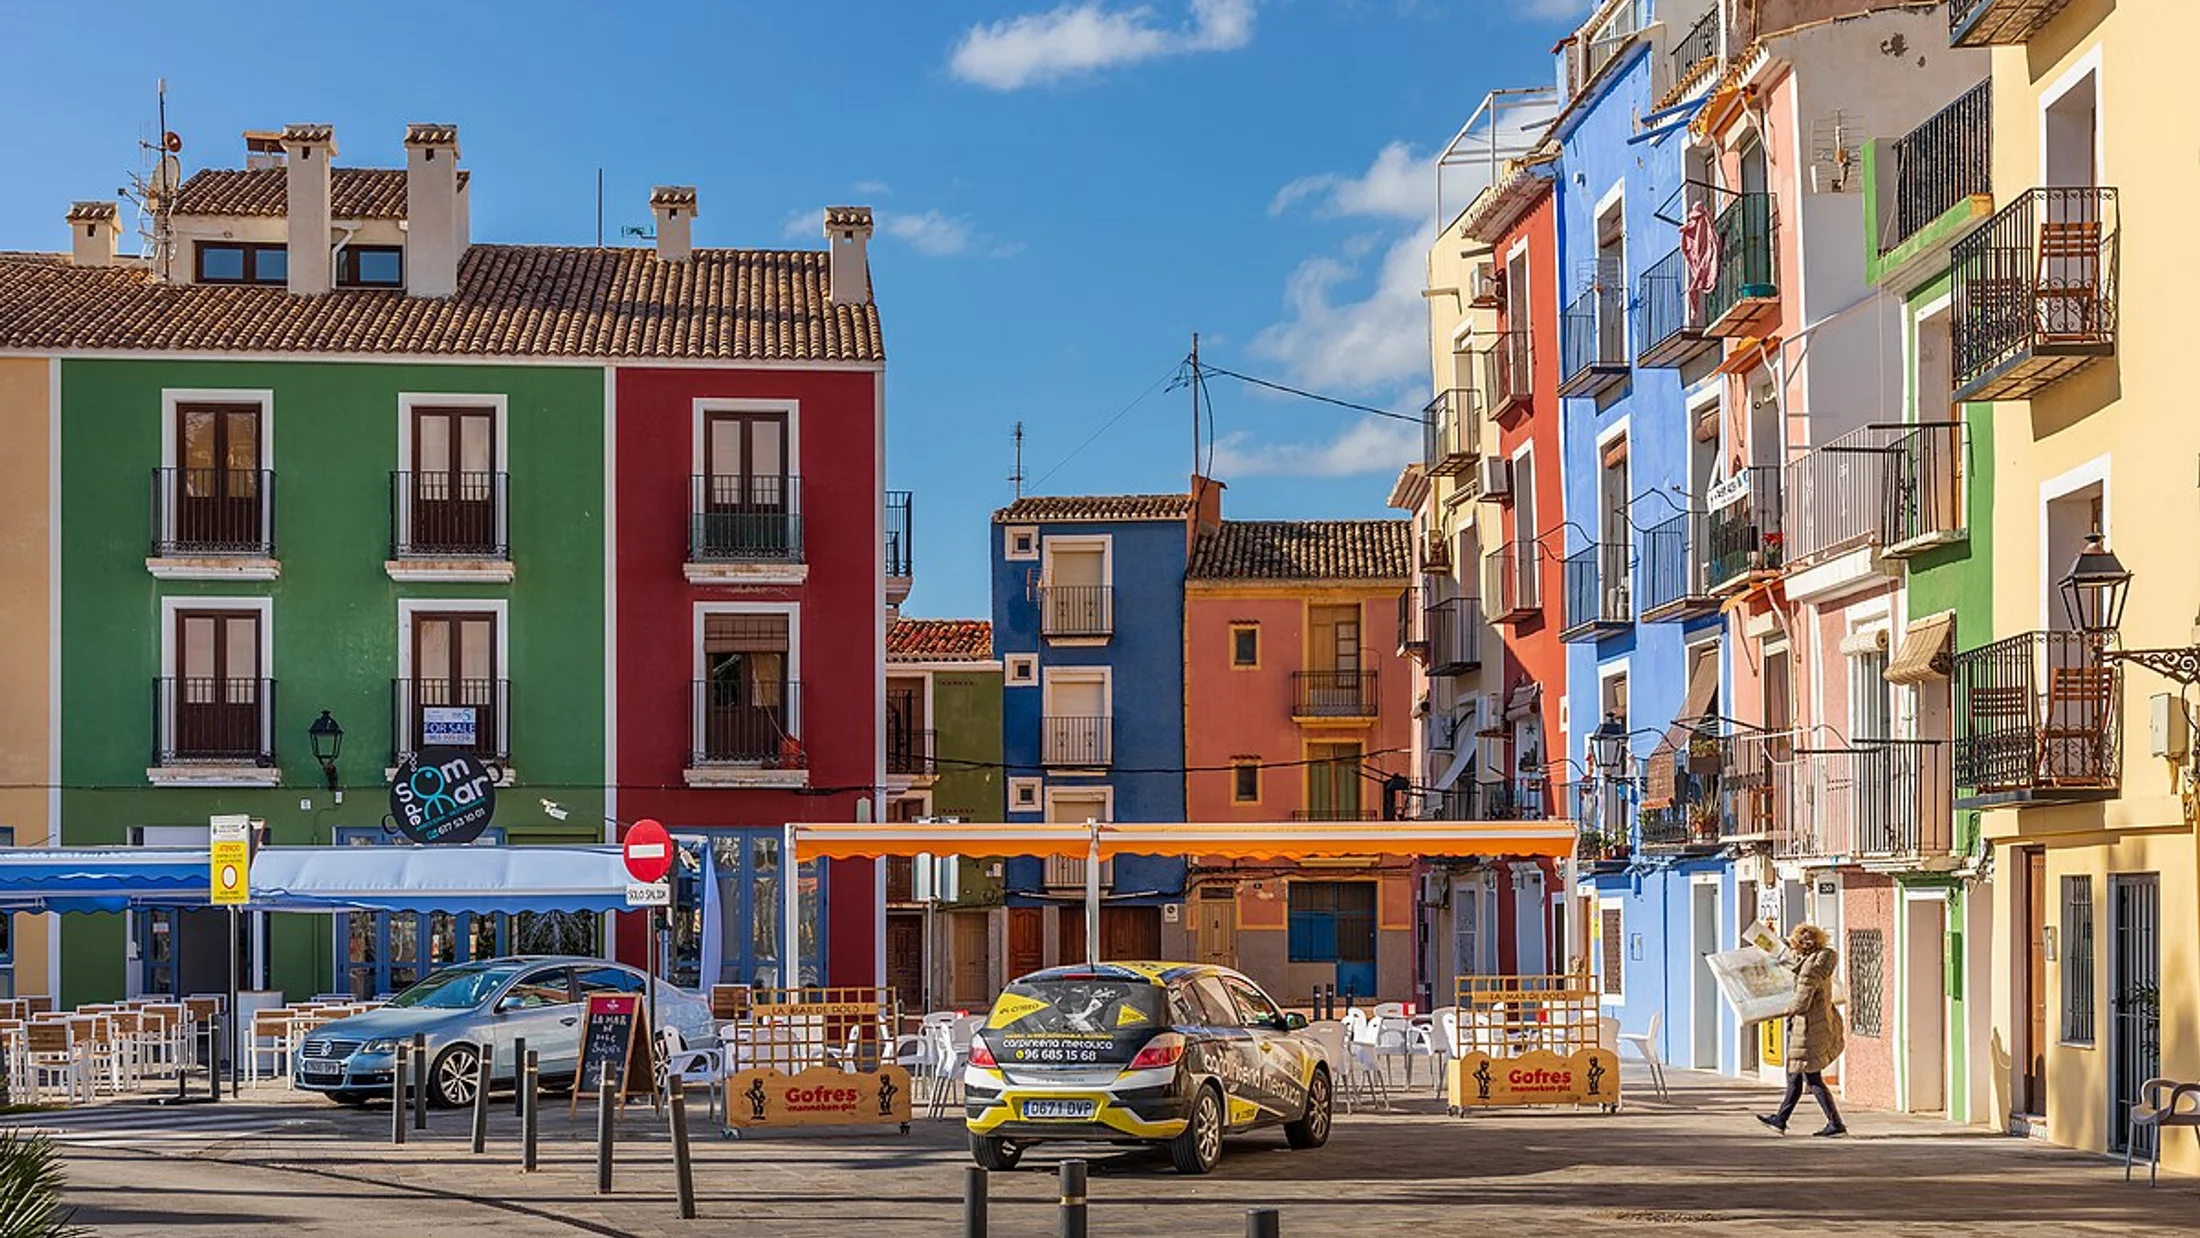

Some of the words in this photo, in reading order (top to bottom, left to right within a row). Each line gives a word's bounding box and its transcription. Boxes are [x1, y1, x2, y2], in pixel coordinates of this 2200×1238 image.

[424, 722, 448, 734] FOR
[448, 722, 476, 734] SALE
[629, 889, 644, 901] SOLO
[645, 889, 667, 900] SALIDA
[1025, 1048, 1040, 1060] 96
[1041, 1049, 1063, 1061] 685
[1065, 1050, 1078, 1061] 15
[1080, 1050, 1097, 1062] 68
[1509, 1068, 1573, 1085] Gofres
[785, 1085, 858, 1103] Gofres
[1031, 1100, 1065, 1116] 0671
[1067, 1100, 1093, 1116] DVP
